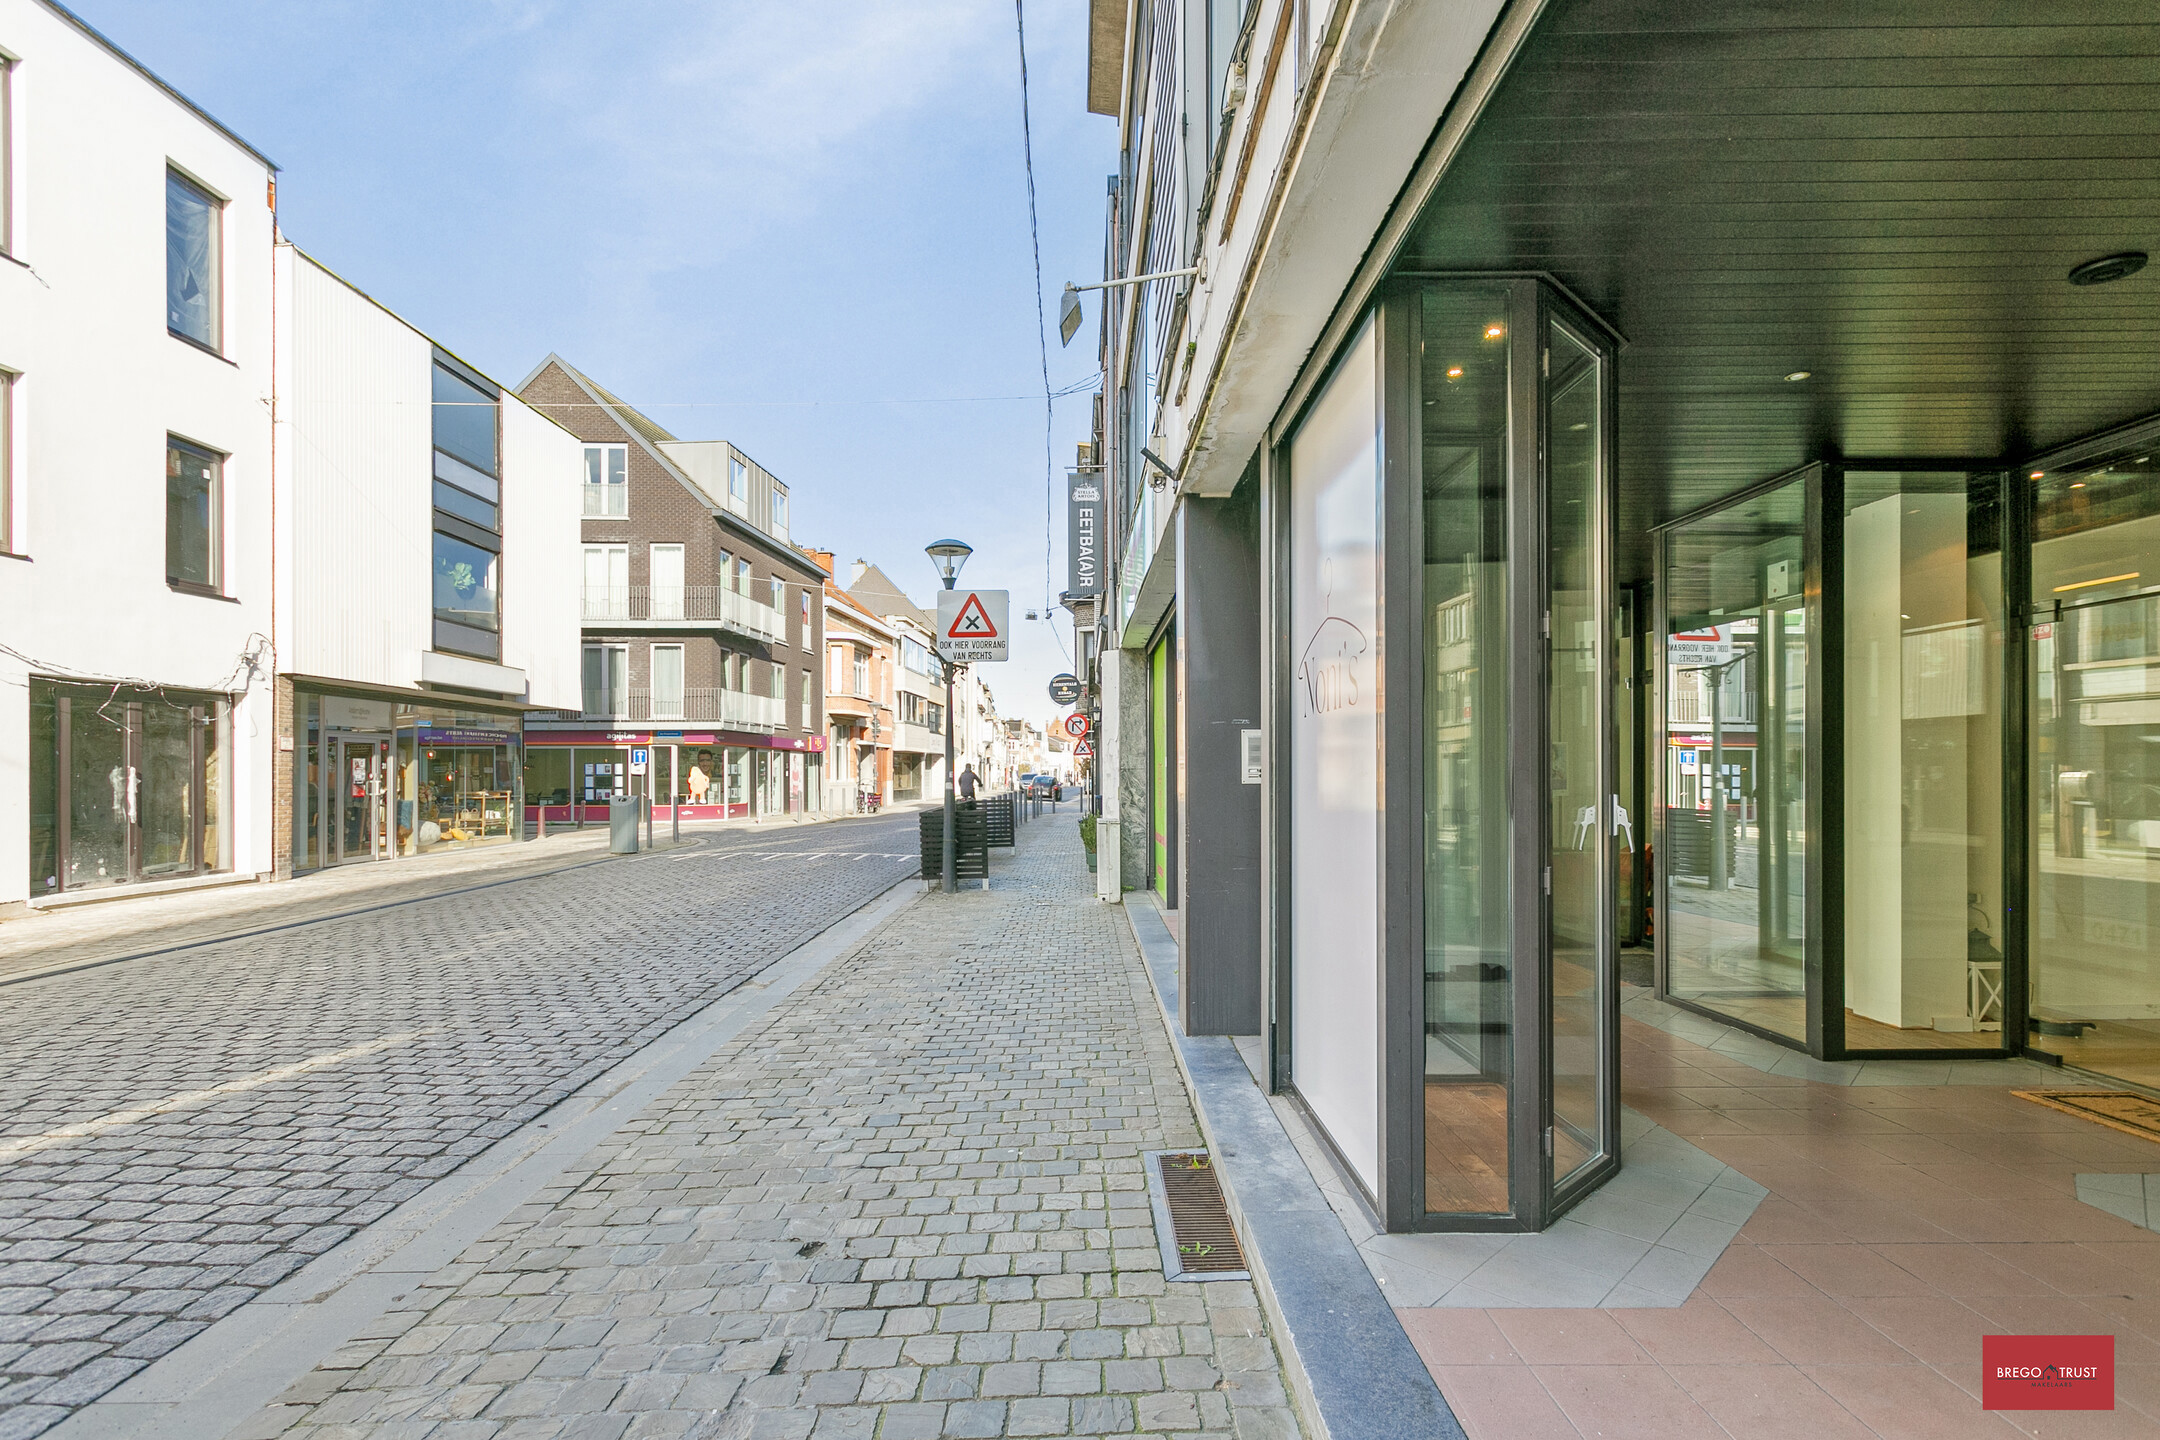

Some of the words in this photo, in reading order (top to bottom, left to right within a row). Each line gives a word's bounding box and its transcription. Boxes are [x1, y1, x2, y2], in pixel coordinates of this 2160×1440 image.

[1077, 507, 1096, 587] EETBA(A)R
[939, 641, 952, 649] OOK
[954, 640, 969, 649] HIER
[971, 640, 1006, 649] VOORRANG
[952, 651, 966, 660] VAN
[967, 651, 993, 660] RECHTS
[1303, 640, 1359, 718] Noni's
